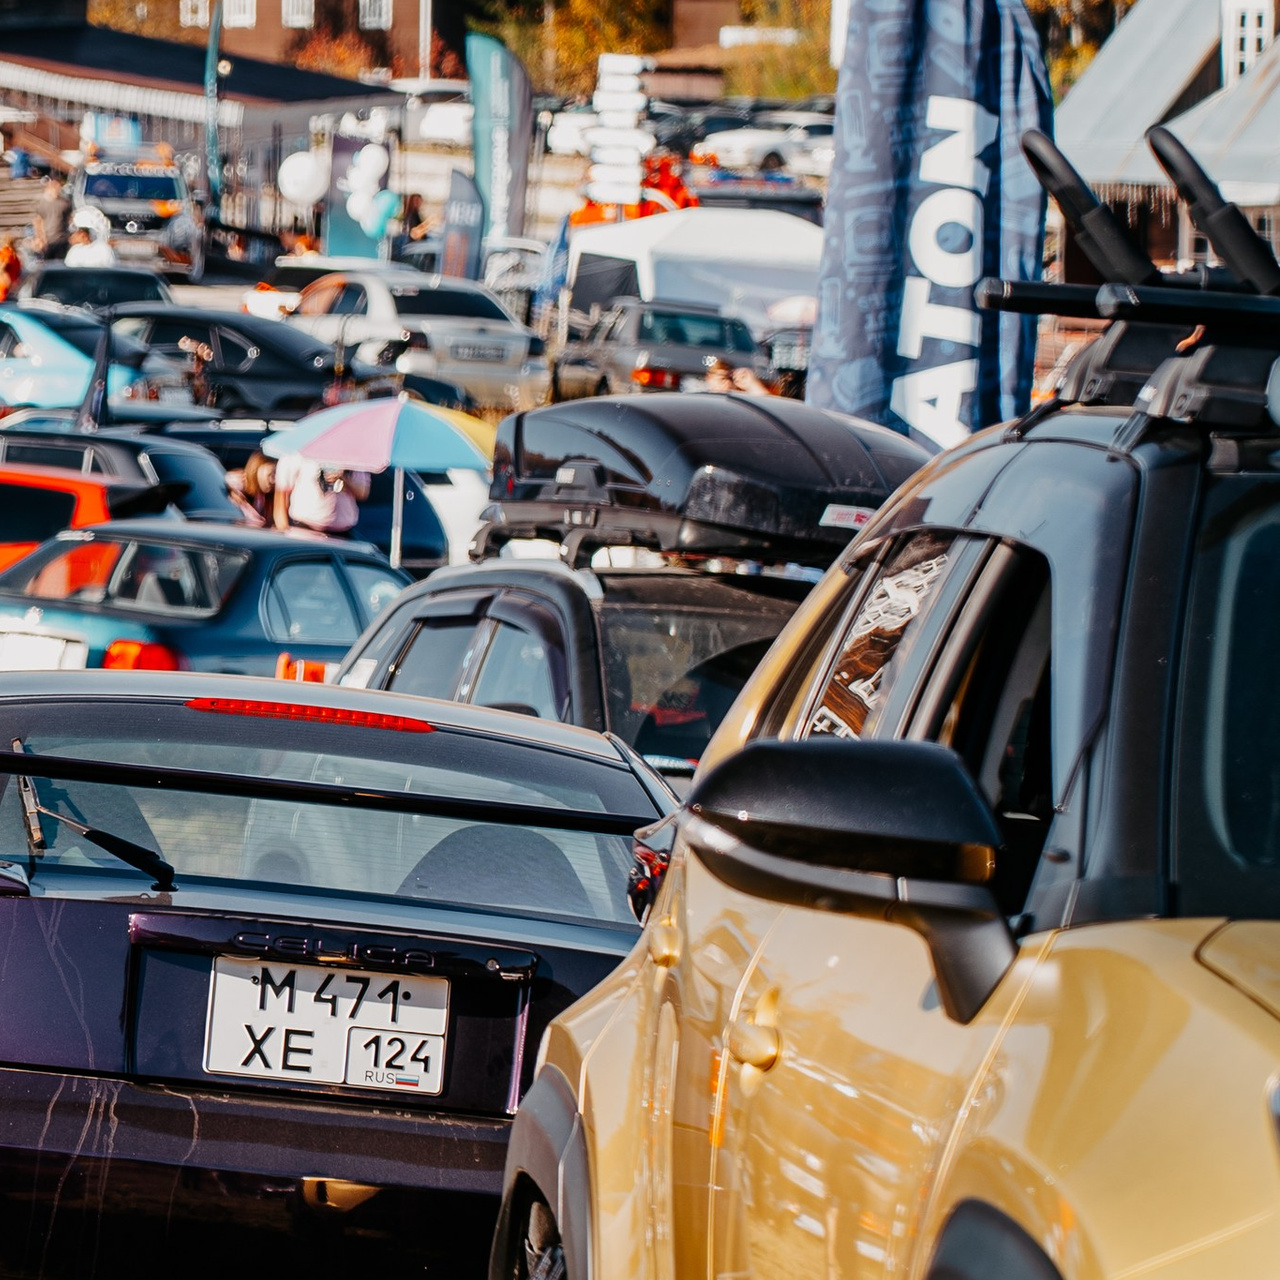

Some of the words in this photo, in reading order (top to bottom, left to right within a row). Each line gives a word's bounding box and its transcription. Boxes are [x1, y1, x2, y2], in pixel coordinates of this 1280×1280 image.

[234, 931, 436, 968] CELICA
[313, 973, 400, 1023] 471
[363, 1035, 430, 1073] 124
[365, 1070, 395, 1084] RUS
